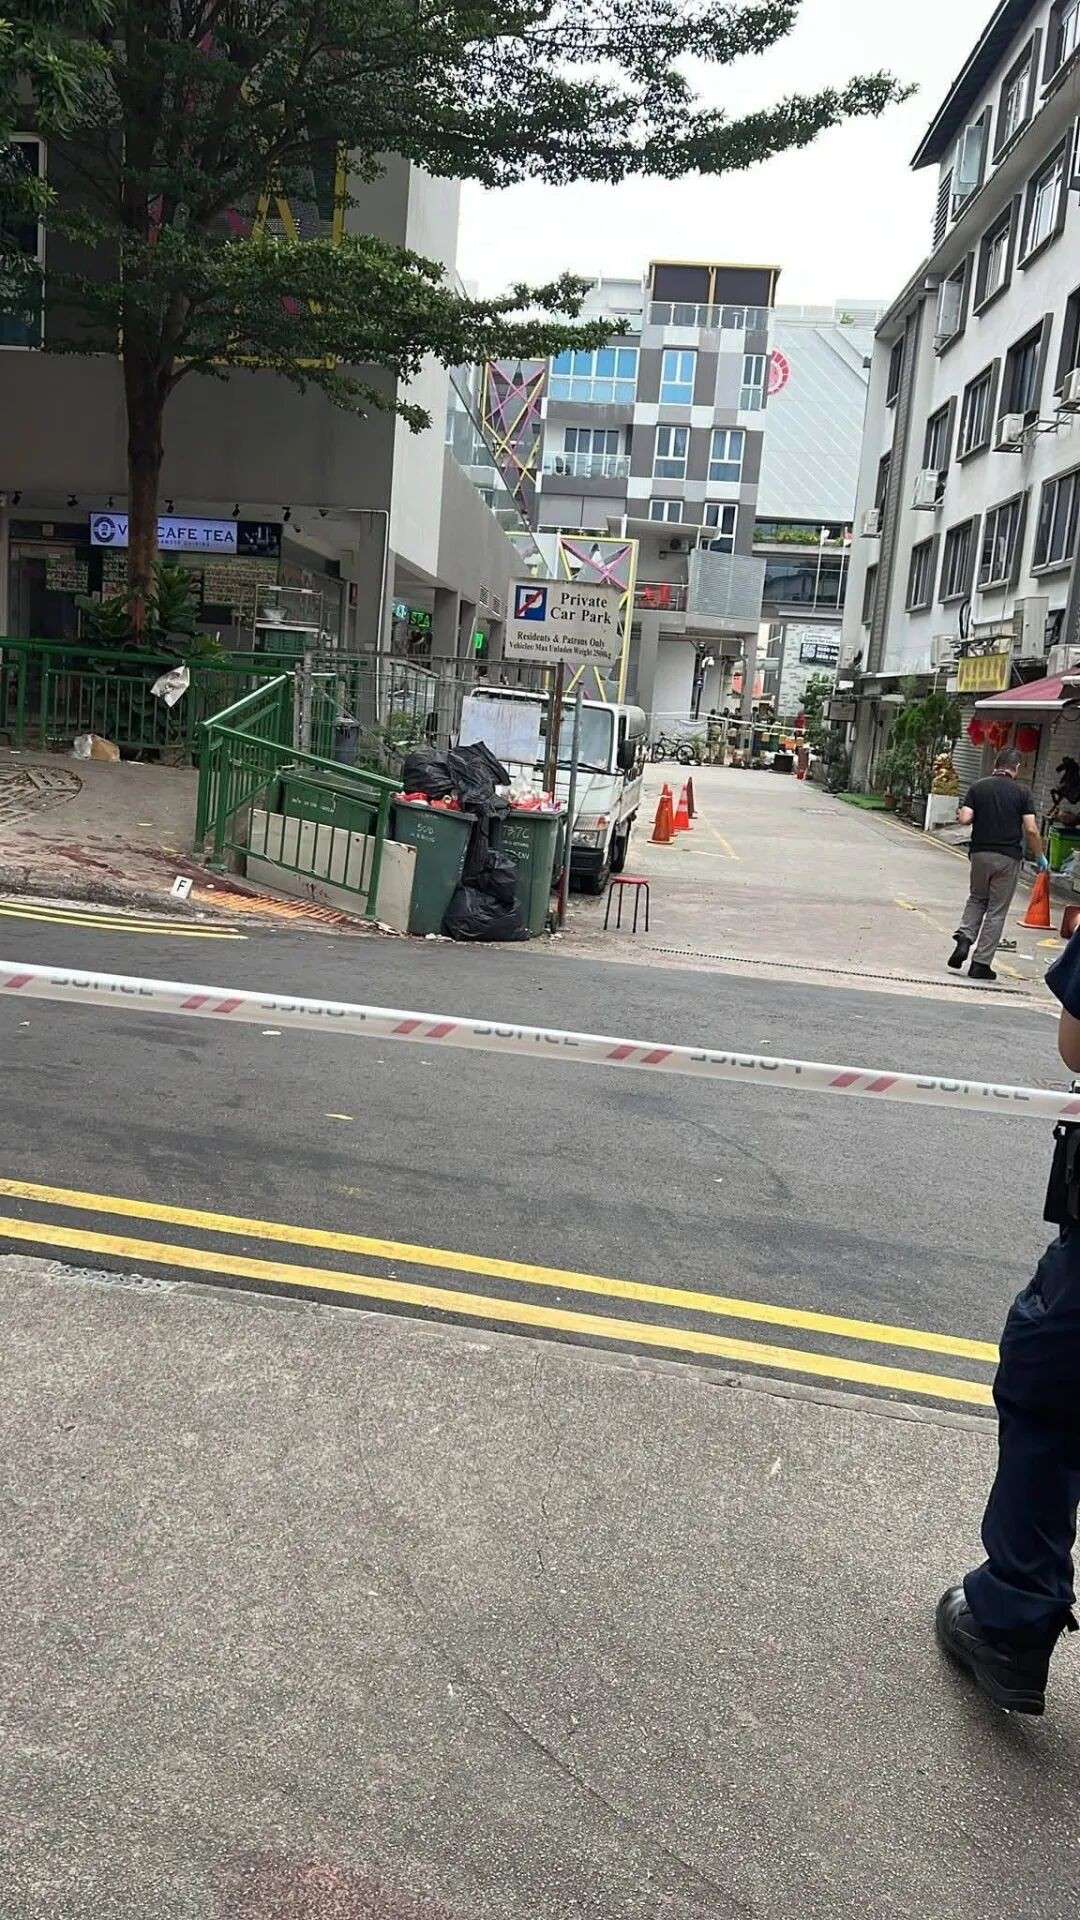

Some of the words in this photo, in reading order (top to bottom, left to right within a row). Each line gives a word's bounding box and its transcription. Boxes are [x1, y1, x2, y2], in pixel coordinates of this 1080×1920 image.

[157, 526, 198, 541] CAFE
[203, 529, 235, 543] TEA
[561, 592, 608, 608] Private
[550, 606, 576, 621] Car
[582, 609, 612, 625] Park
[517, 631, 551, 642] Residents
[553, 634, 559, 643] &
[562, 635, 588, 646] Patrons
[590, 638, 605, 649] Only
[177, 879, 187, 892] F
